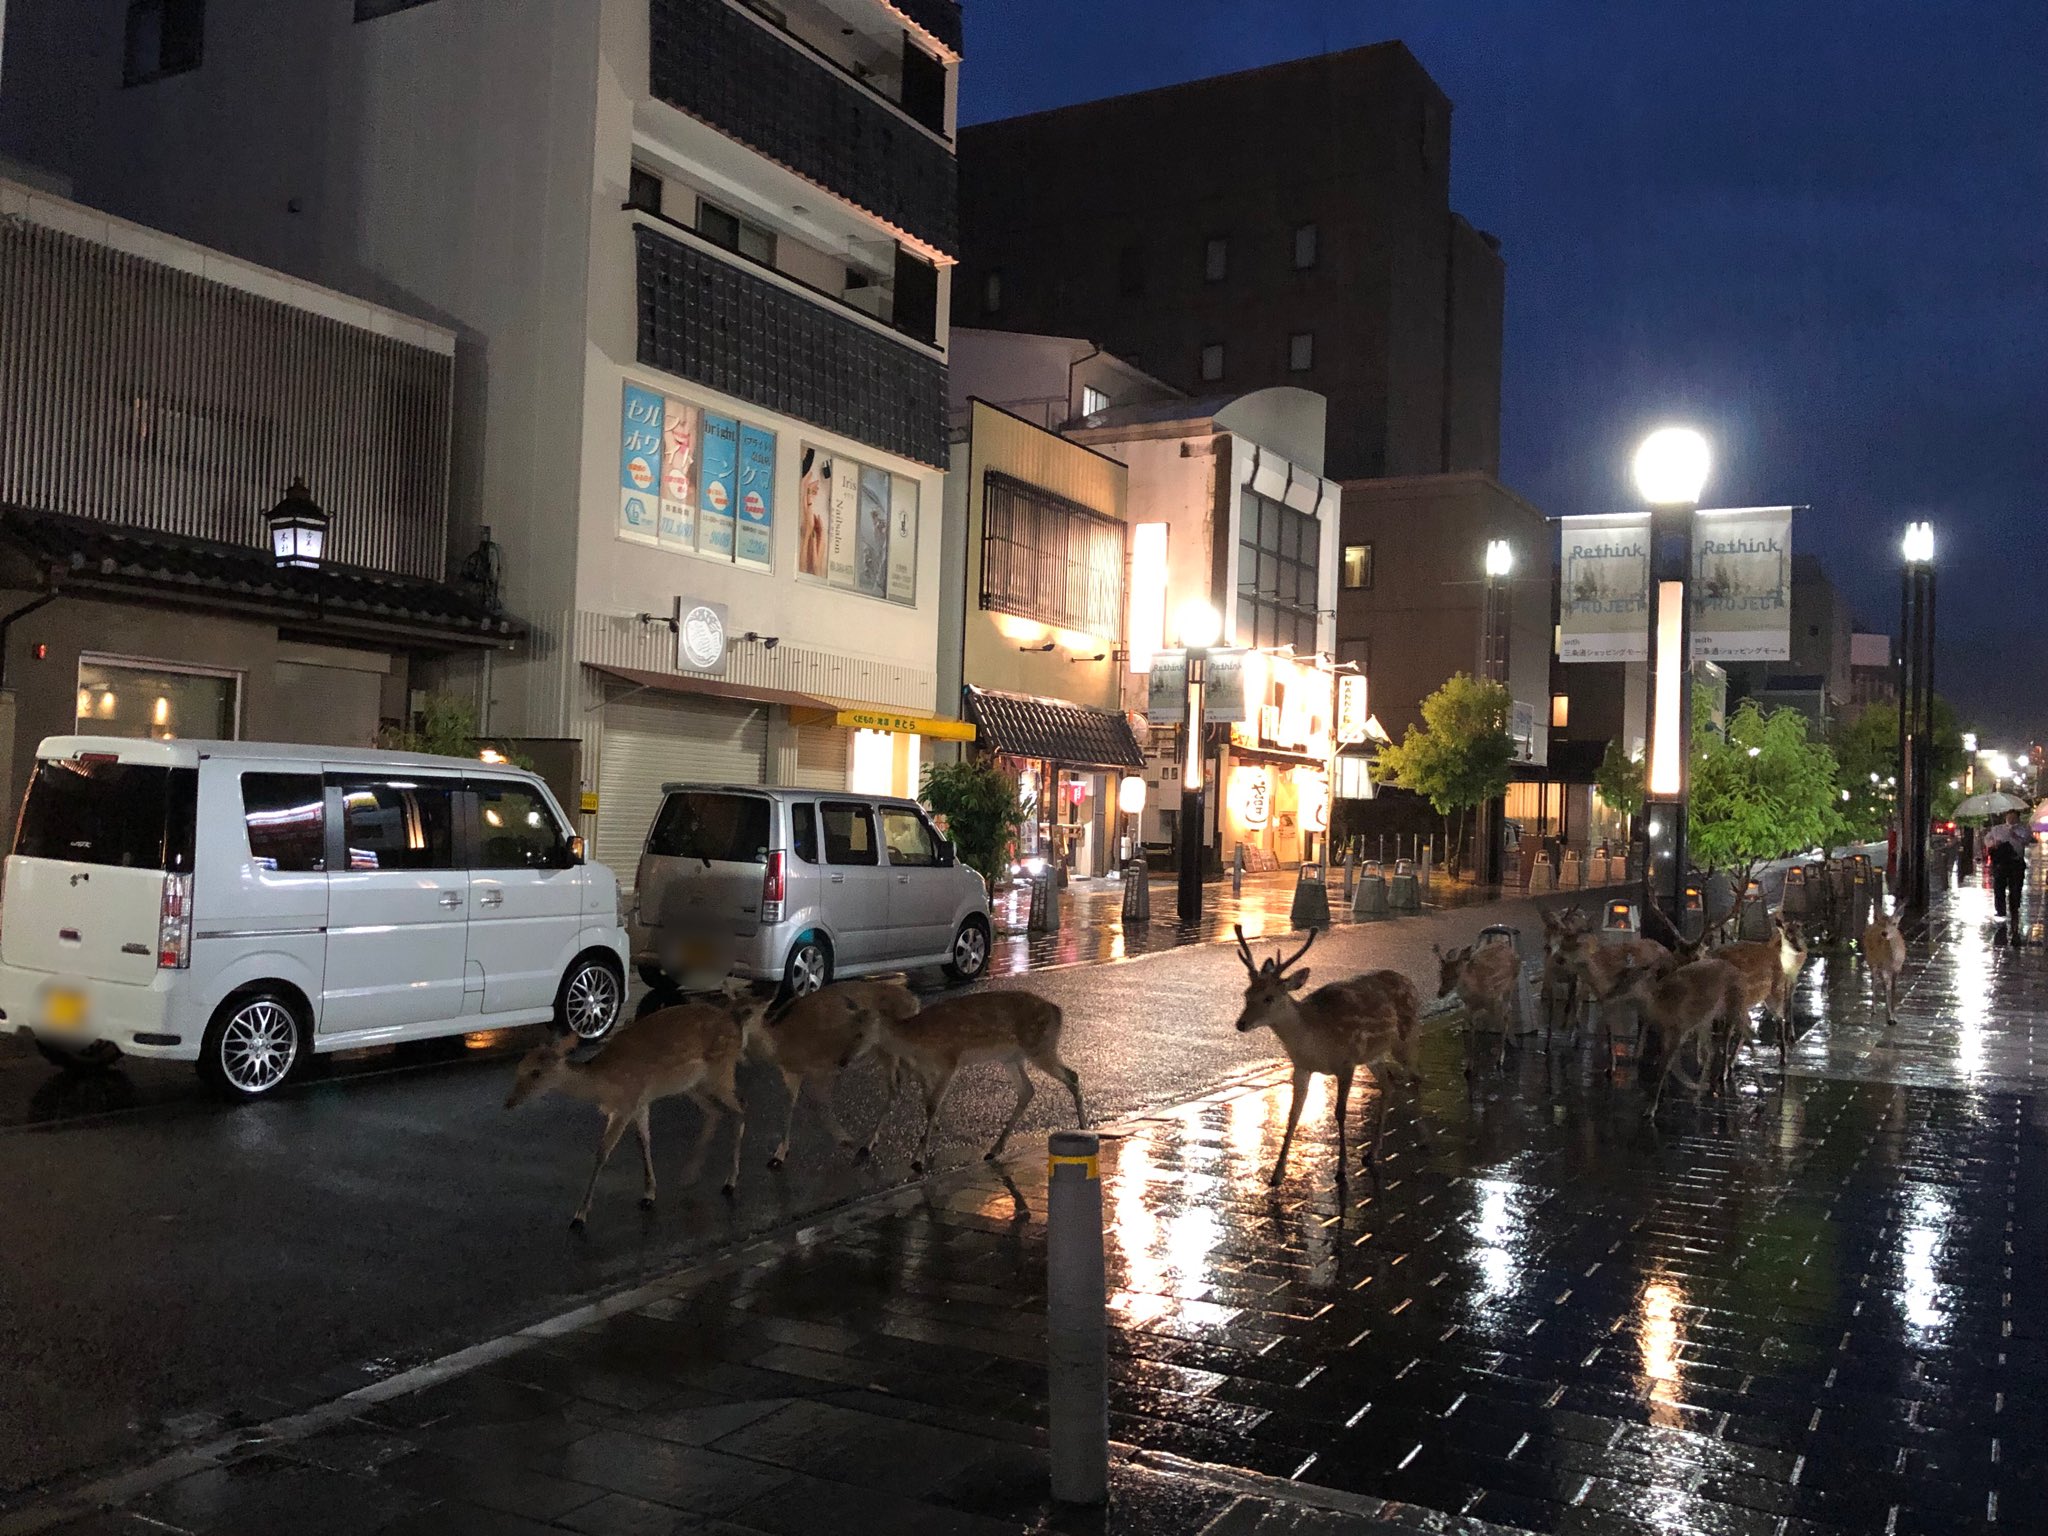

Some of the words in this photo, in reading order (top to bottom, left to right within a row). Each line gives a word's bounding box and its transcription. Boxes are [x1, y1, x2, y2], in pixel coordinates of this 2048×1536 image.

[842, 475, 857, 491] Iris
[1573, 544, 1644, 558] Rethink
[1704, 538, 1779, 555] Rethink
